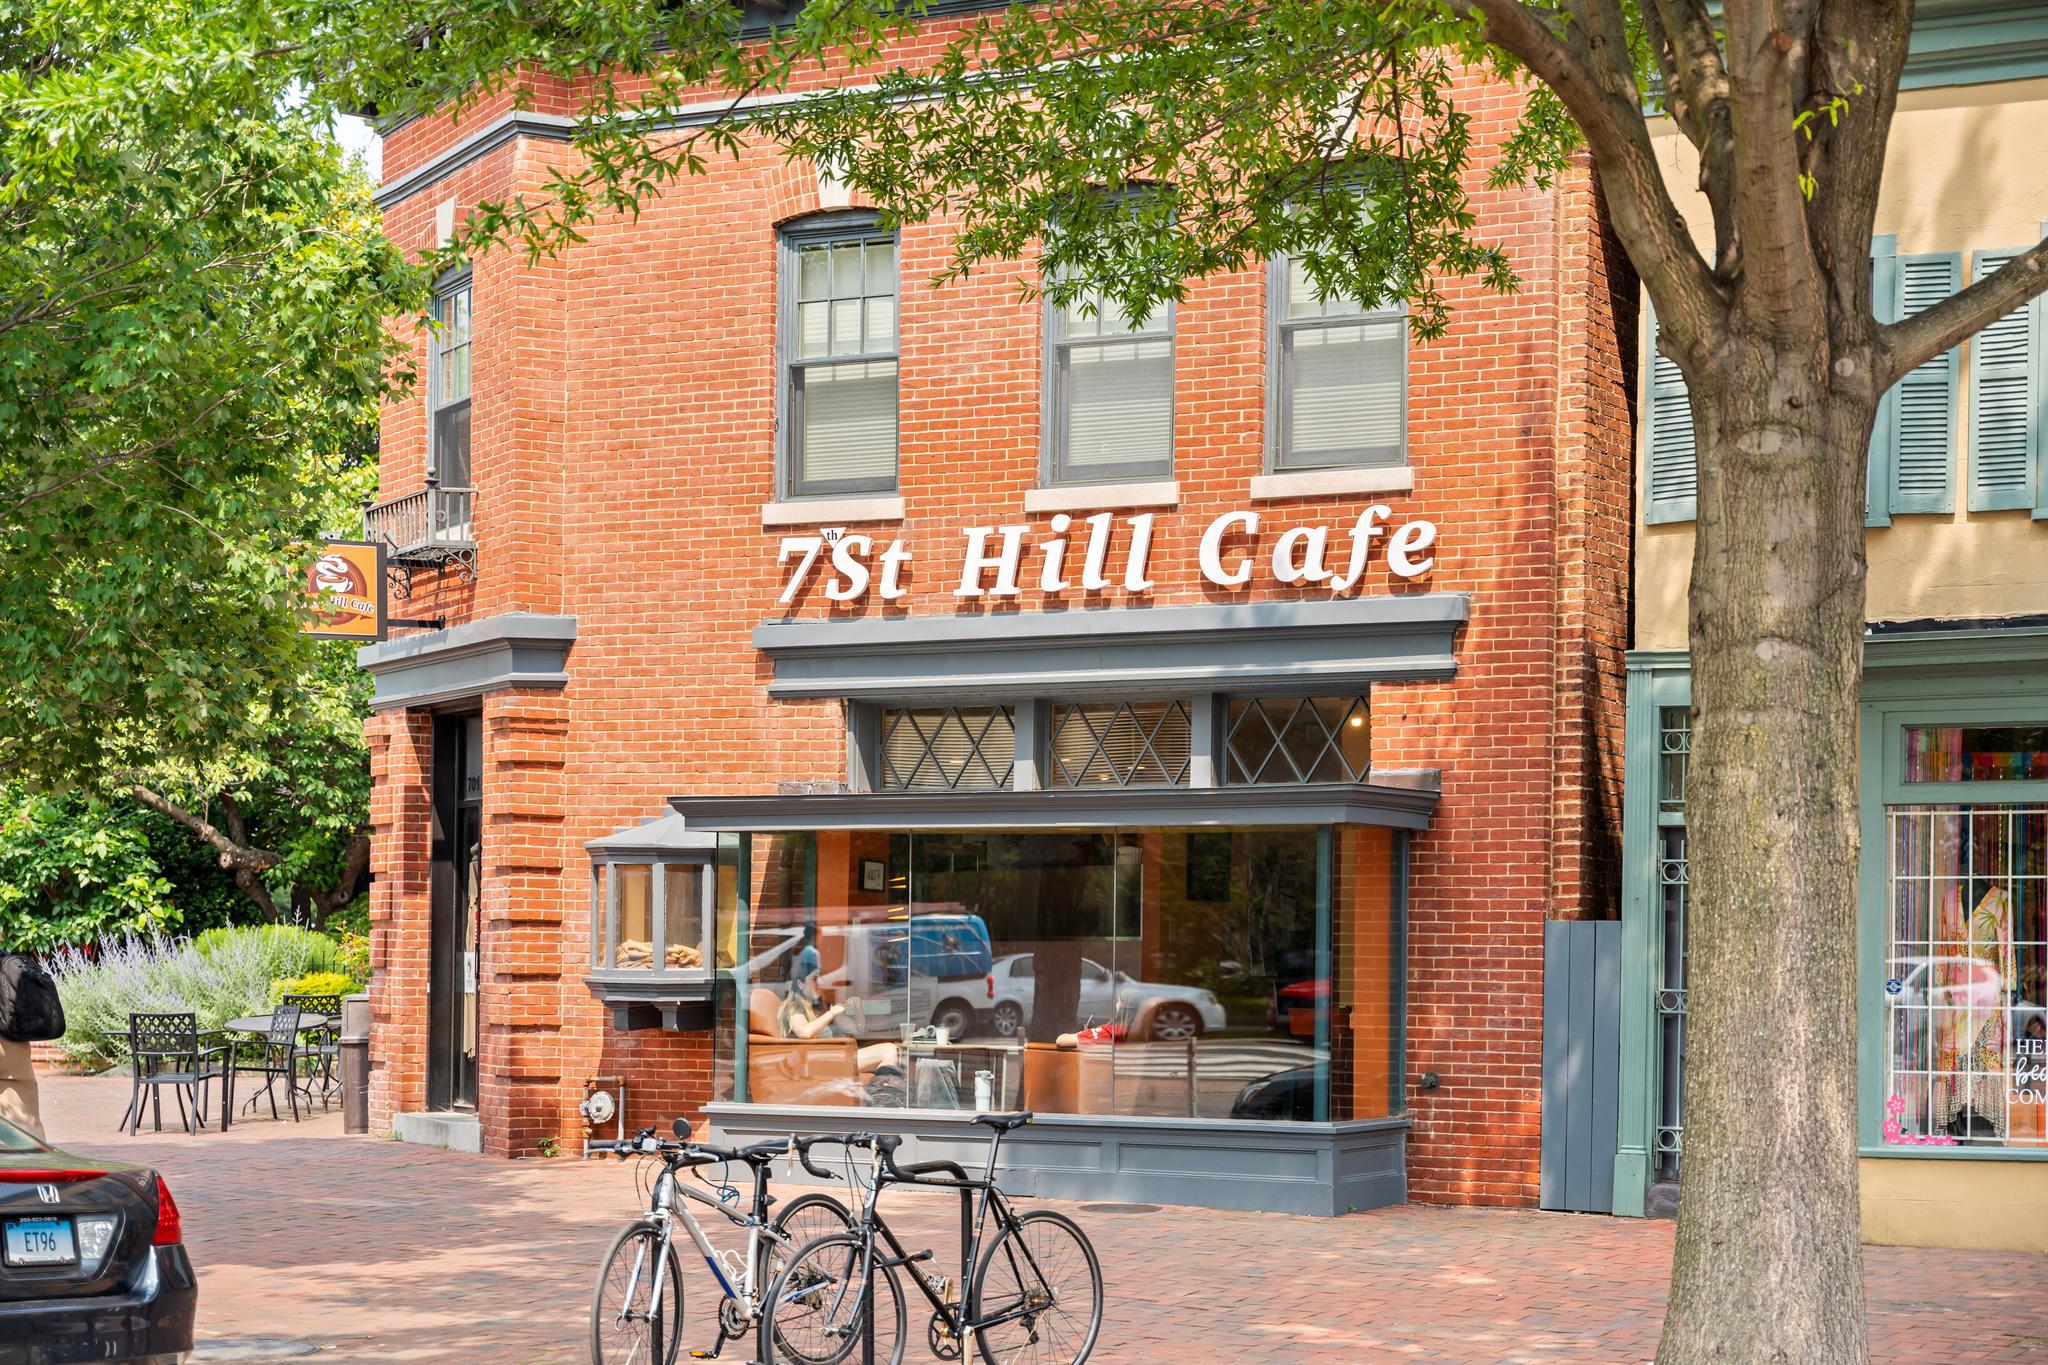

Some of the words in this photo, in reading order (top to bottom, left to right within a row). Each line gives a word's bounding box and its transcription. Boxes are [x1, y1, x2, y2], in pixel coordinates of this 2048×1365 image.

[825, 534, 913, 601] St
[953, 512, 1154, 597] Hill
[1199, 504, 1437, 592] Cafe
[351, 599, 375, 613] Cafe
[467, 776, 480, 792] 701
[2015, 1038, 2048, 1055] HE
[24, 1231, 56, 1252] ET96
